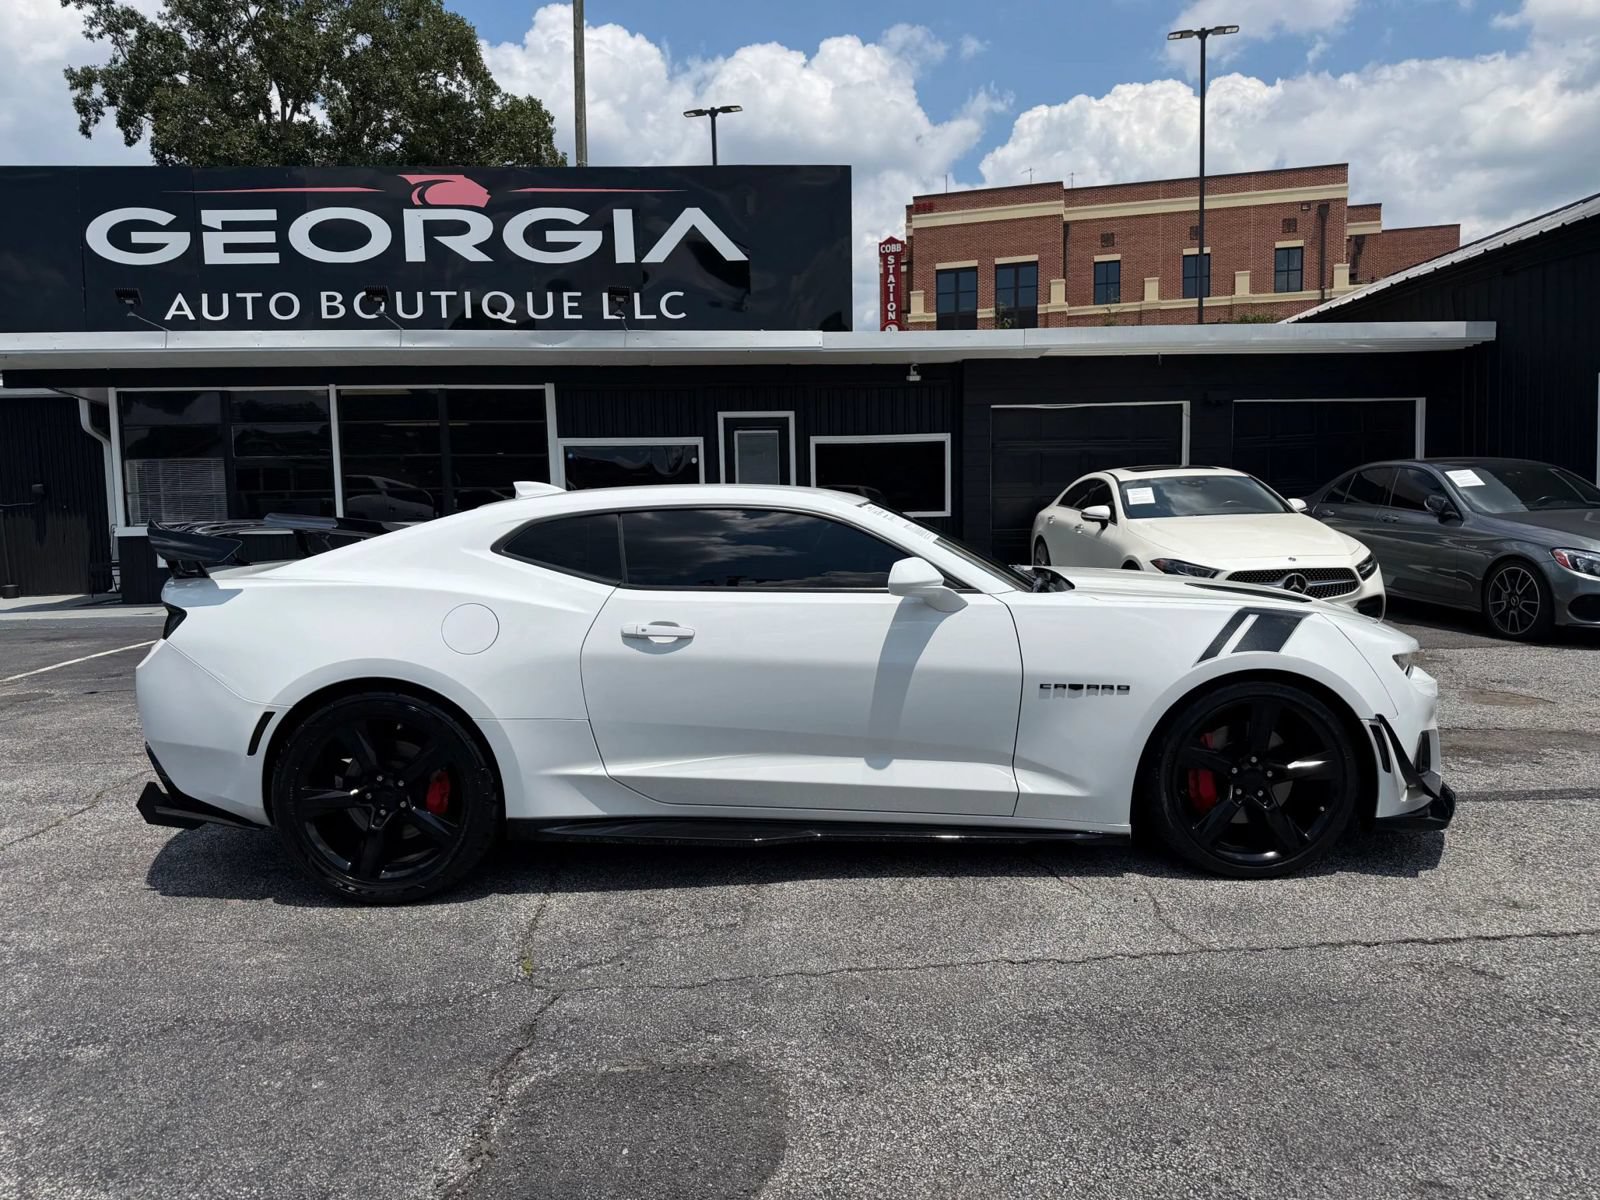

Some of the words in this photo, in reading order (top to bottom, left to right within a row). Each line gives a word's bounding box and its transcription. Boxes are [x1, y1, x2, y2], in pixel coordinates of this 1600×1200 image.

[85, 207, 749, 265] GEORGIA
[880, 244, 902, 253] COBB
[164, 291, 301, 321] AUTO
[320, 290, 584, 324] BOUTIQUE
[602, 290, 687, 320] LLC
[887, 255, 896, 320] STATION
